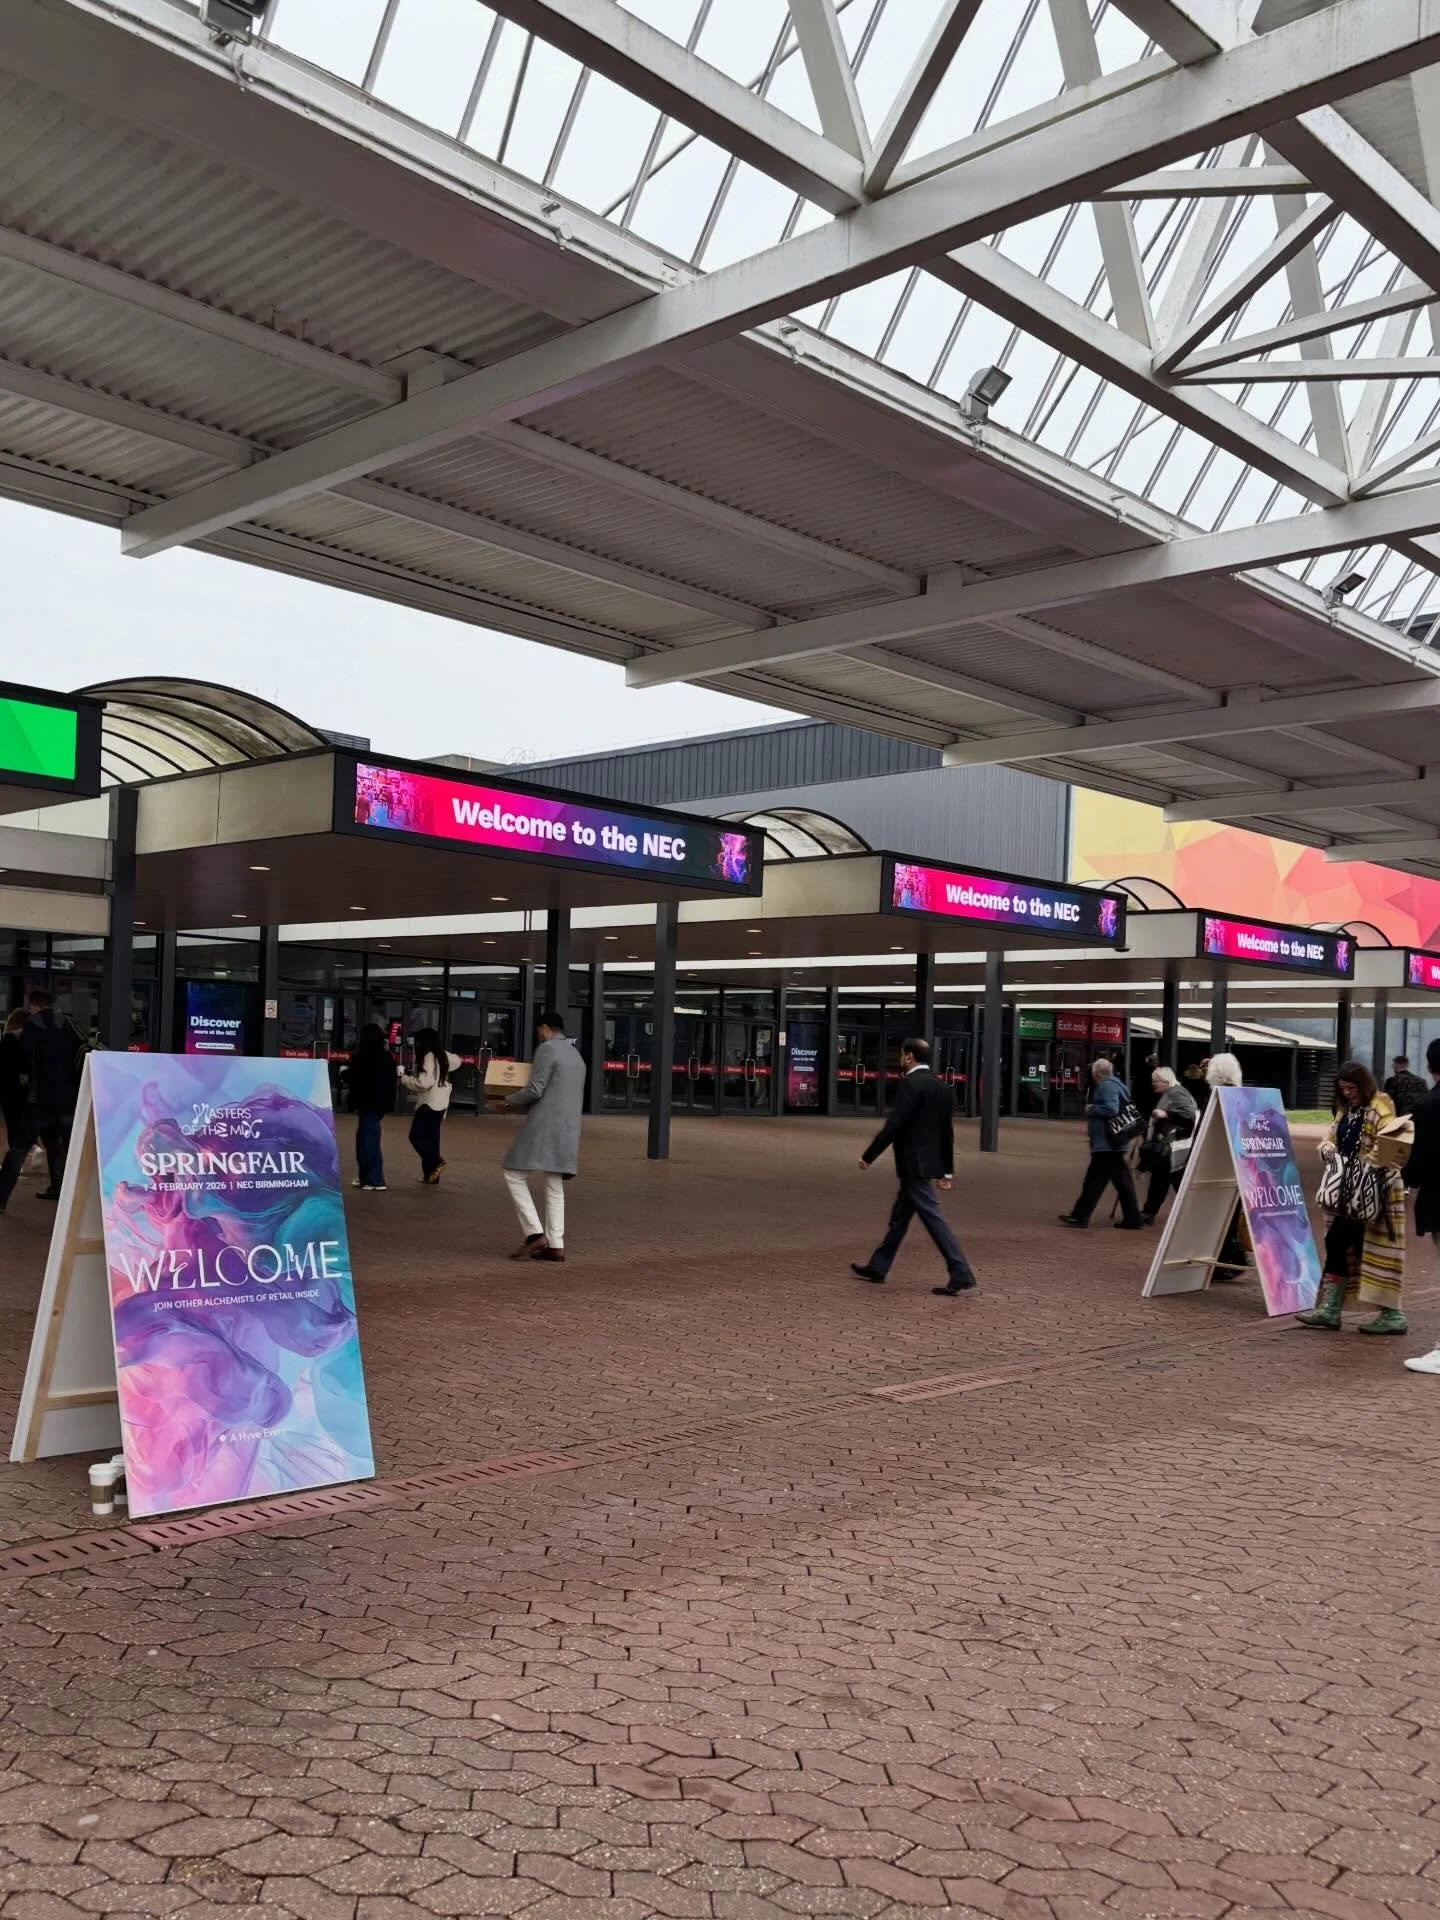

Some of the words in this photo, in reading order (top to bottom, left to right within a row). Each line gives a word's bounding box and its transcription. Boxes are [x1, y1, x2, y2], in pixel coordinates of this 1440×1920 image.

[452, 798, 567, 842] Welcome
[572, 820, 596, 846] to
[601, 826, 638, 854] the
[642, 832, 686, 861] NEC
[945, 883, 1010, 912] Welcome
[1013, 895, 1027, 914] to
[1029, 897, 1051, 917] the
[1053, 902, 1081, 922] NEC
[1237, 933, 1279, 954] Welcome
[1280, 941, 1290, 955] to
[1291, 941, 1306, 958] the
[1306, 944, 1324, 960] NEC
[190, 1016, 241, 1028] Discover
[1020, 1017, 1053, 1030] Entrance
[1057, 1020, 1072, 1031] Exit
[1073, 1021, 1088, 1035] only
[1092, 1022, 1107, 1033] Exit
[1107, 1024, 1121, 1037] only
[791, 1048, 818, 1056] Discover
[192, 1103, 252, 1124] MASTERS
[181, 1124, 198, 1136] OF
[201, 1122, 229, 1138] THE
[230, 1119, 263, 1139] MIX
[1241, 1137, 1285, 1151] SPRINGFAIR
[141, 1151, 307, 1176] SPRINGFAIR
[144, 1182, 158, 1192] 1-4
[159, 1182, 204, 1192] FEBRUARY
[205, 1181, 227, 1190] 2026
[236, 1181, 255, 1190] NEC
[255, 1180, 309, 1190] BIRMINGHAM
[1246, 1184, 1304, 1208] WELCOME
[120, 1240, 343, 1293] WELCOME
[153, 1301, 173, 1313] JOIN
[174, 1299, 203, 1310] OTHER
[204, 1295, 255, 1307] ALCHEMISTS
[255, 1294, 269, 1303] OF
[269, 1291, 295, 1302] RETAIL
[295, 1289, 321, 1300] INSIDE
